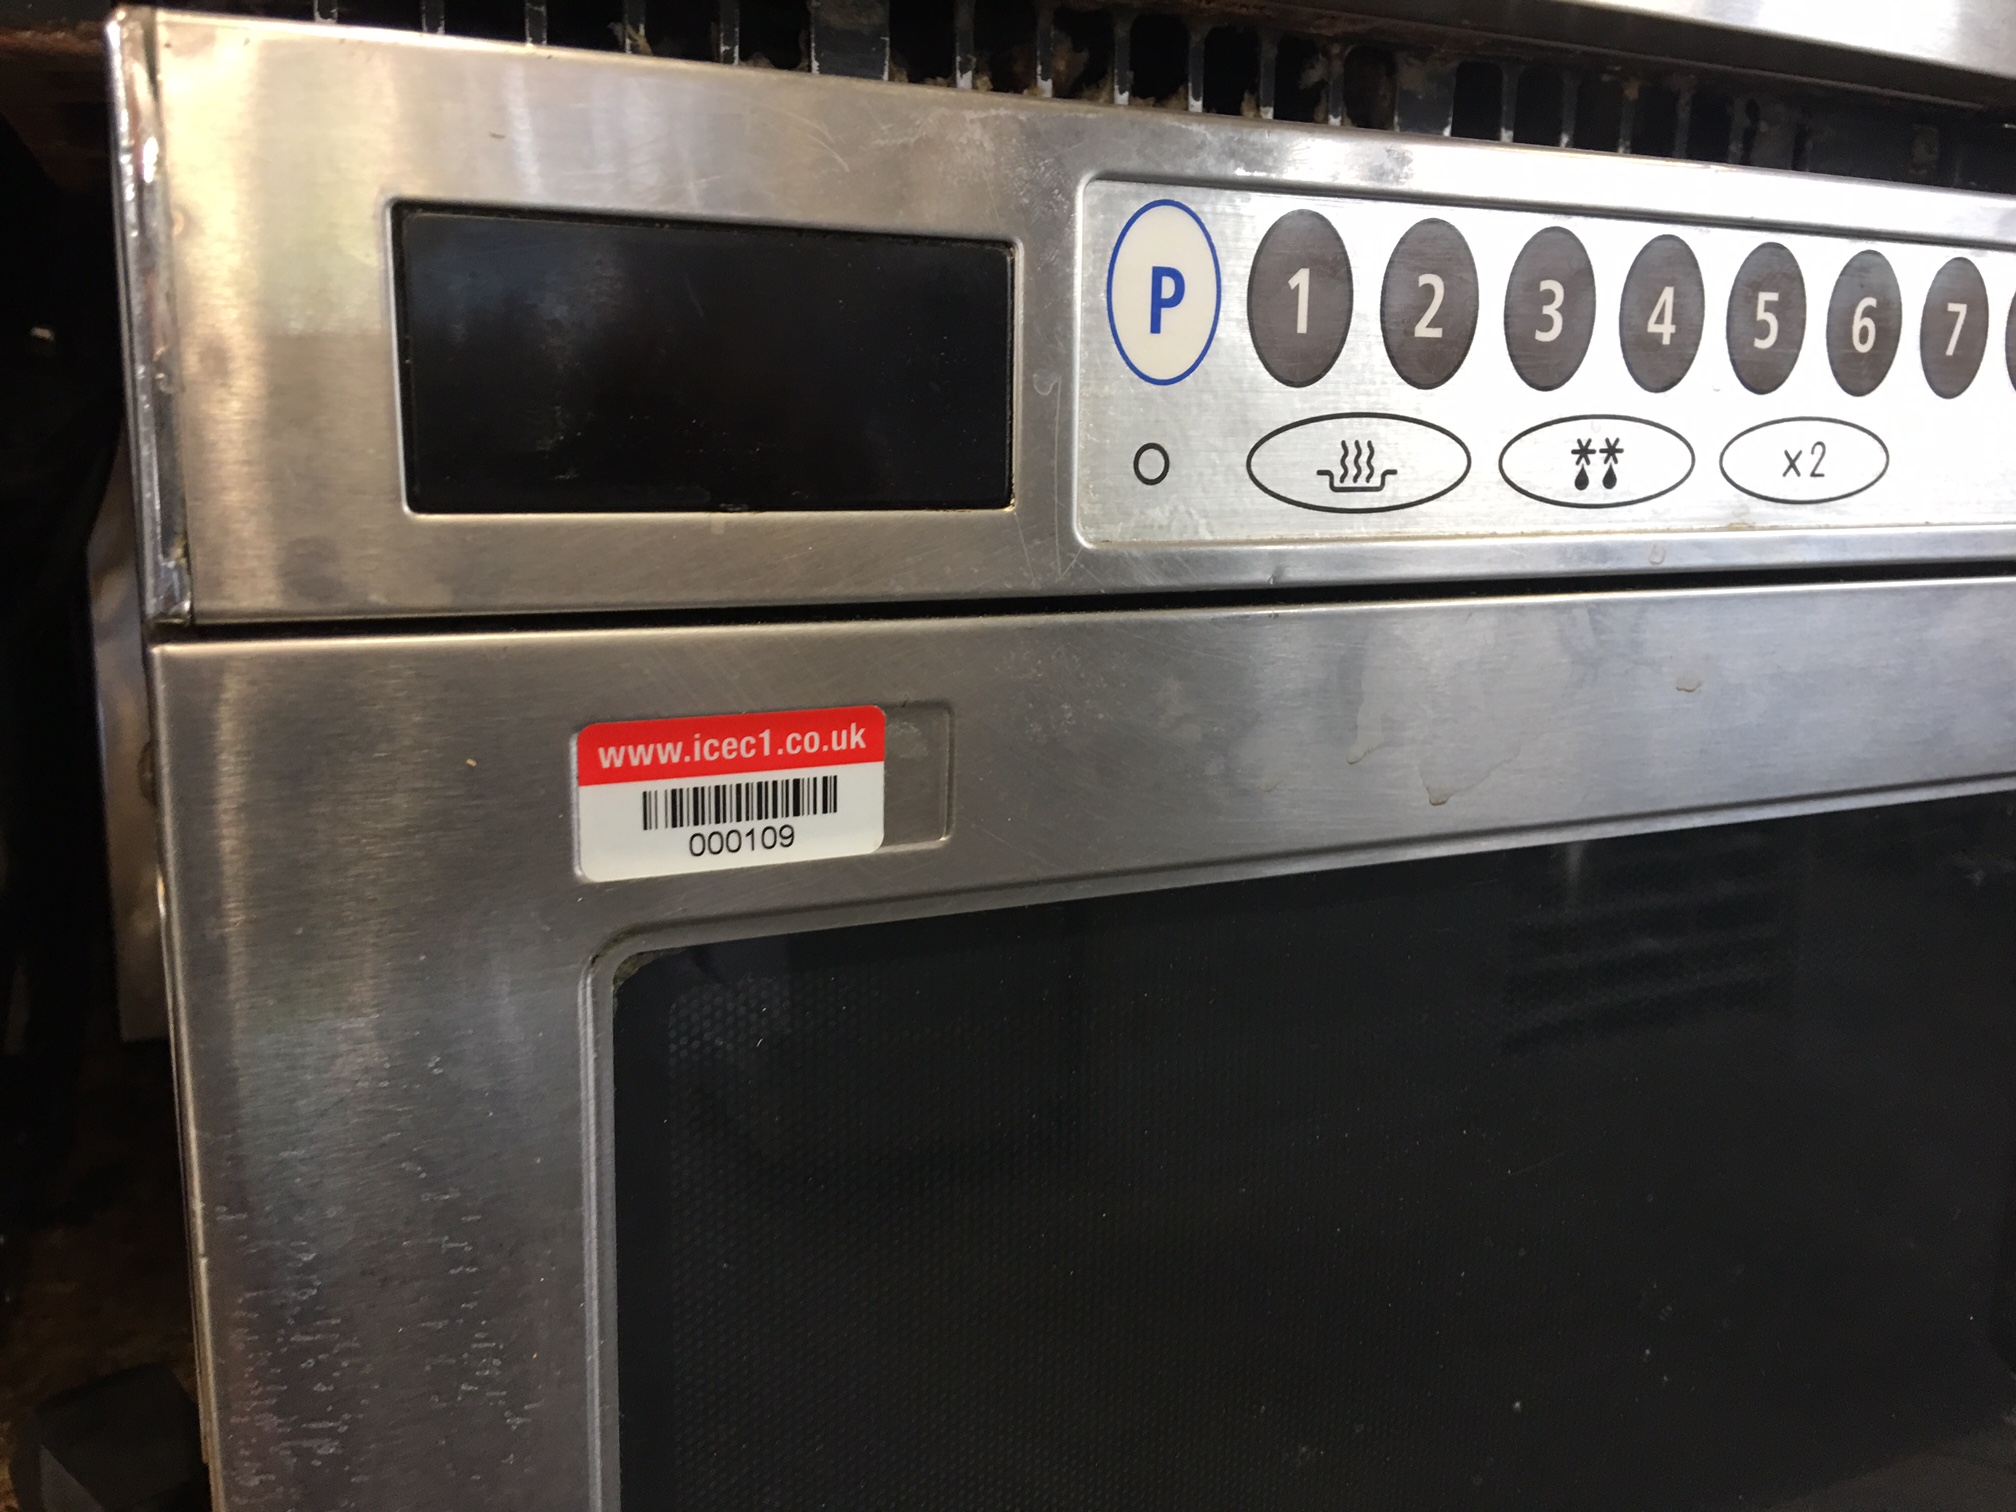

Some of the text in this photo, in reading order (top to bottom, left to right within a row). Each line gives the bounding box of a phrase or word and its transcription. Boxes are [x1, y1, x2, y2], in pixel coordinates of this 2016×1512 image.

[1149, 265, 1186, 335] P
[1287, 267, 1311, 334] 1
[1413, 273, 1446, 338] 2
[1534, 279, 1566, 343] 3
[1646, 286, 1676, 346] 4
[1753, 291, 1780, 350] 5
[1851, 296, 1878, 354] 6
[1945, 302, 1968, 356] 7
[1782, 441, 1827, 478] x2
[597, 722, 867, 769] www.icec1.co.uk
[688, 824, 796, 857] 000109
